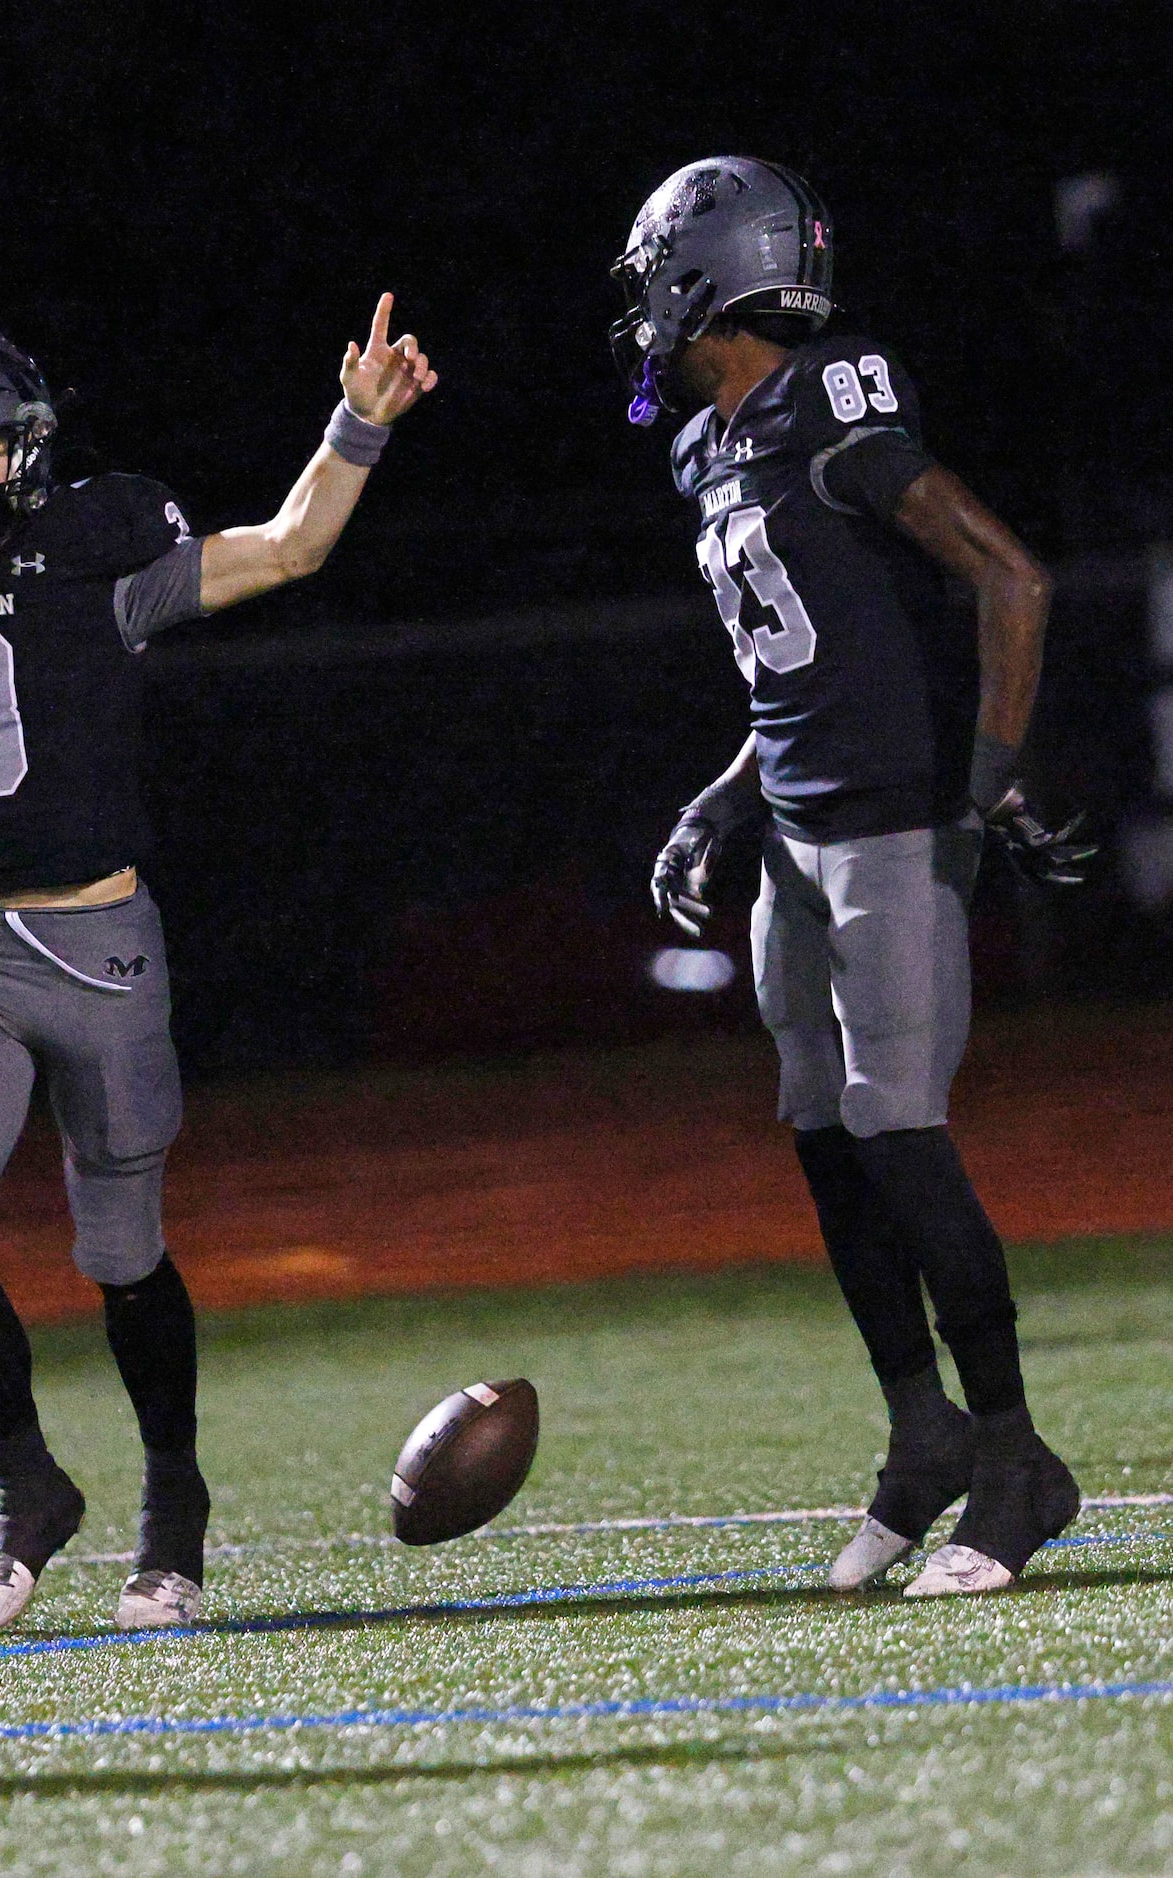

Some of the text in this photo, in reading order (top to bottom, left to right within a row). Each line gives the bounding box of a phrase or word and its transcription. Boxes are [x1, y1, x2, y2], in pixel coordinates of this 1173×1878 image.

[823, 355, 899, 423] 83
[703, 480, 742, 518] MARTIN
[165, 501, 192, 545] 3
